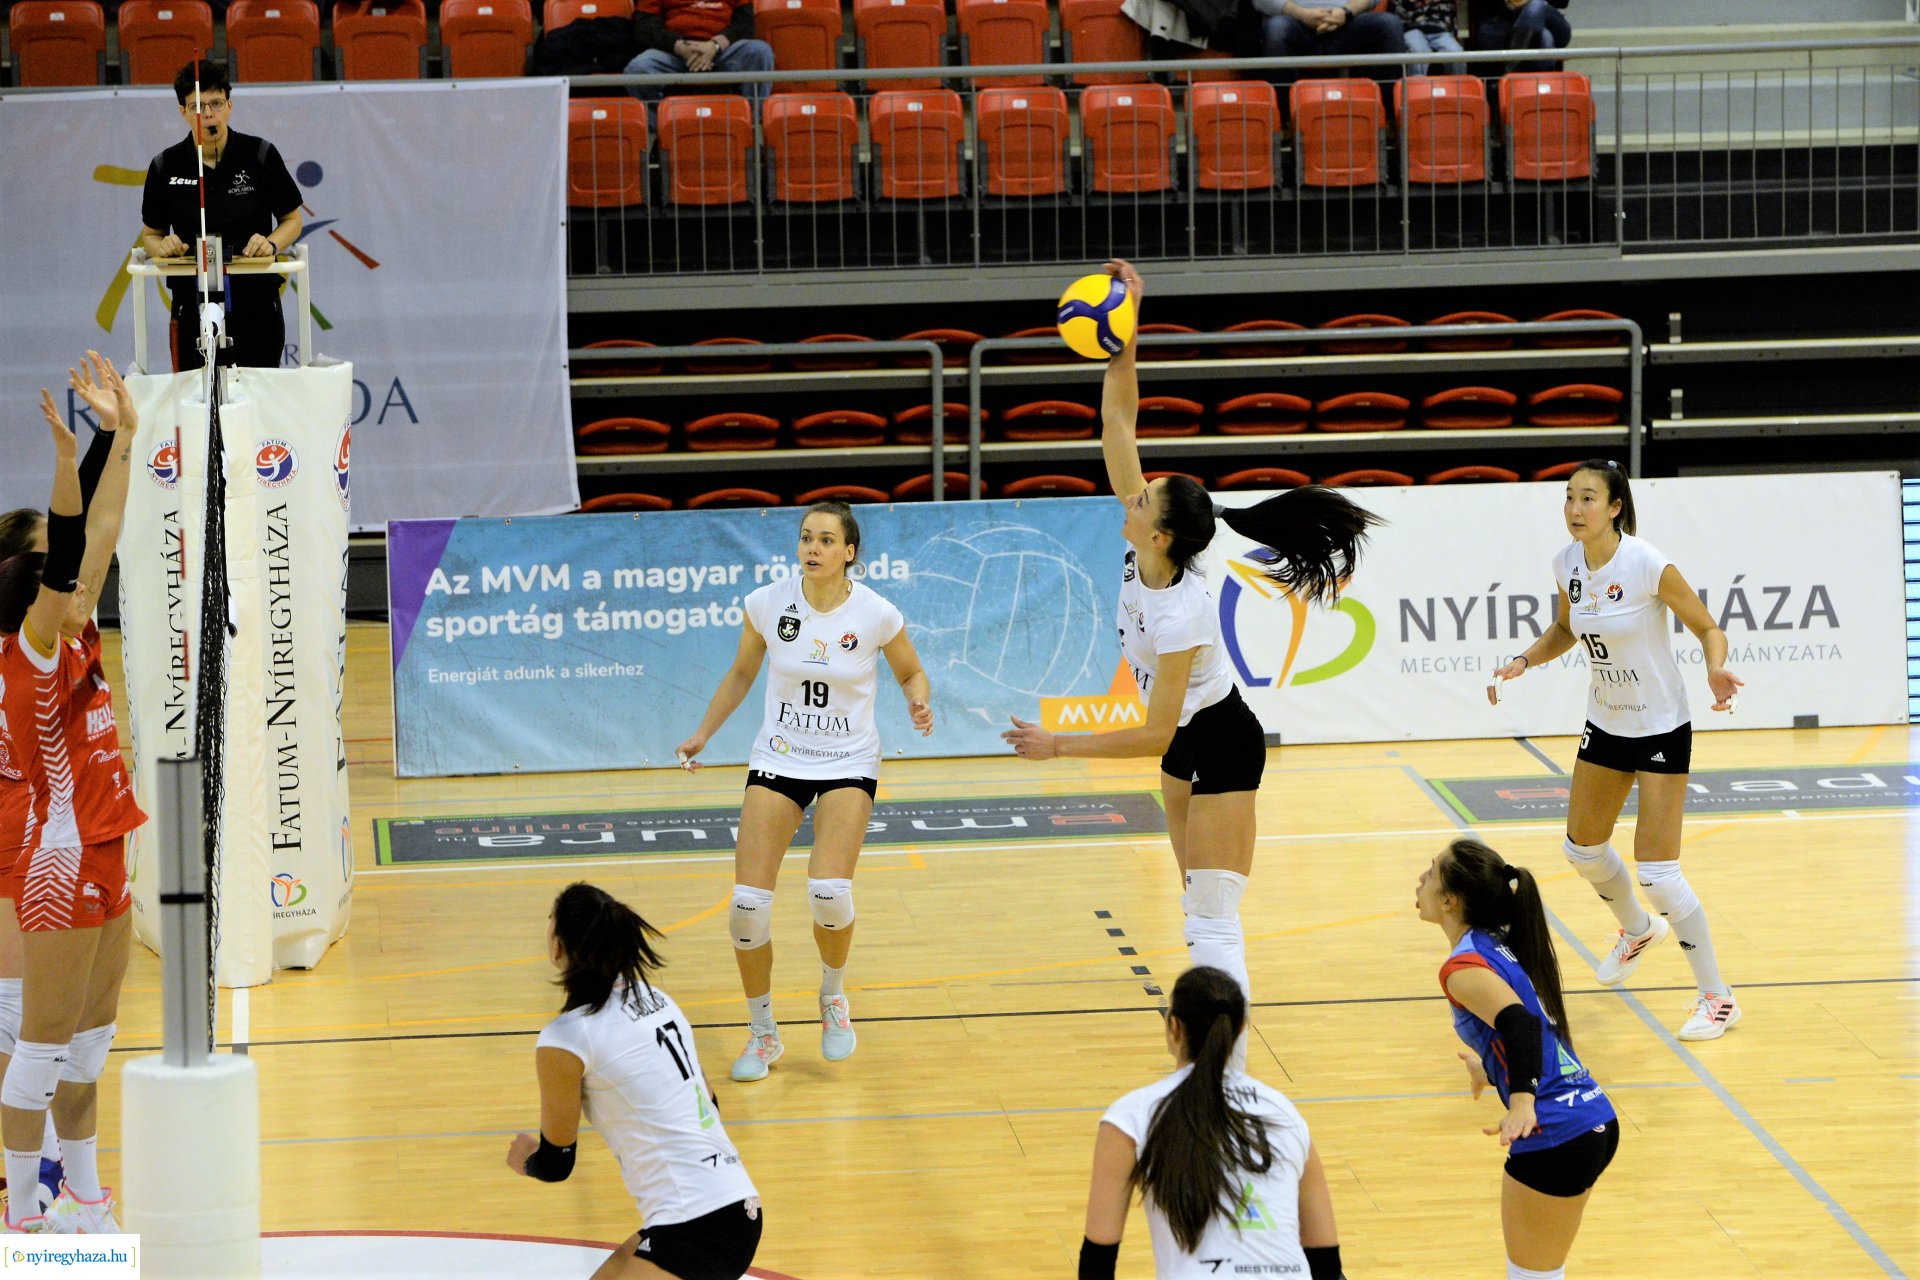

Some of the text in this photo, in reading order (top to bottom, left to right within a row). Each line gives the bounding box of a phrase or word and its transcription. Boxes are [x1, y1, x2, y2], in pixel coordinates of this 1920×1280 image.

[169, 177, 198, 185] Zeus
[425, 567, 471, 596] Az
[481, 563, 570, 595] MVM
[582, 569, 601, 591] a
[614, 563, 743, 595] magyar
[427, 603, 564, 643] sportág
[1580, 633, 1609, 660] 15
[428, 662, 644, 685] Energiát adunk a sikerhez
[1401, 656, 1482, 674] MEGYEI
[801, 679, 829, 709] 19
[777, 701, 851, 732] FATUM
[1058, 702, 1141, 725] MVM
[655, 1020, 694, 1082] 17
